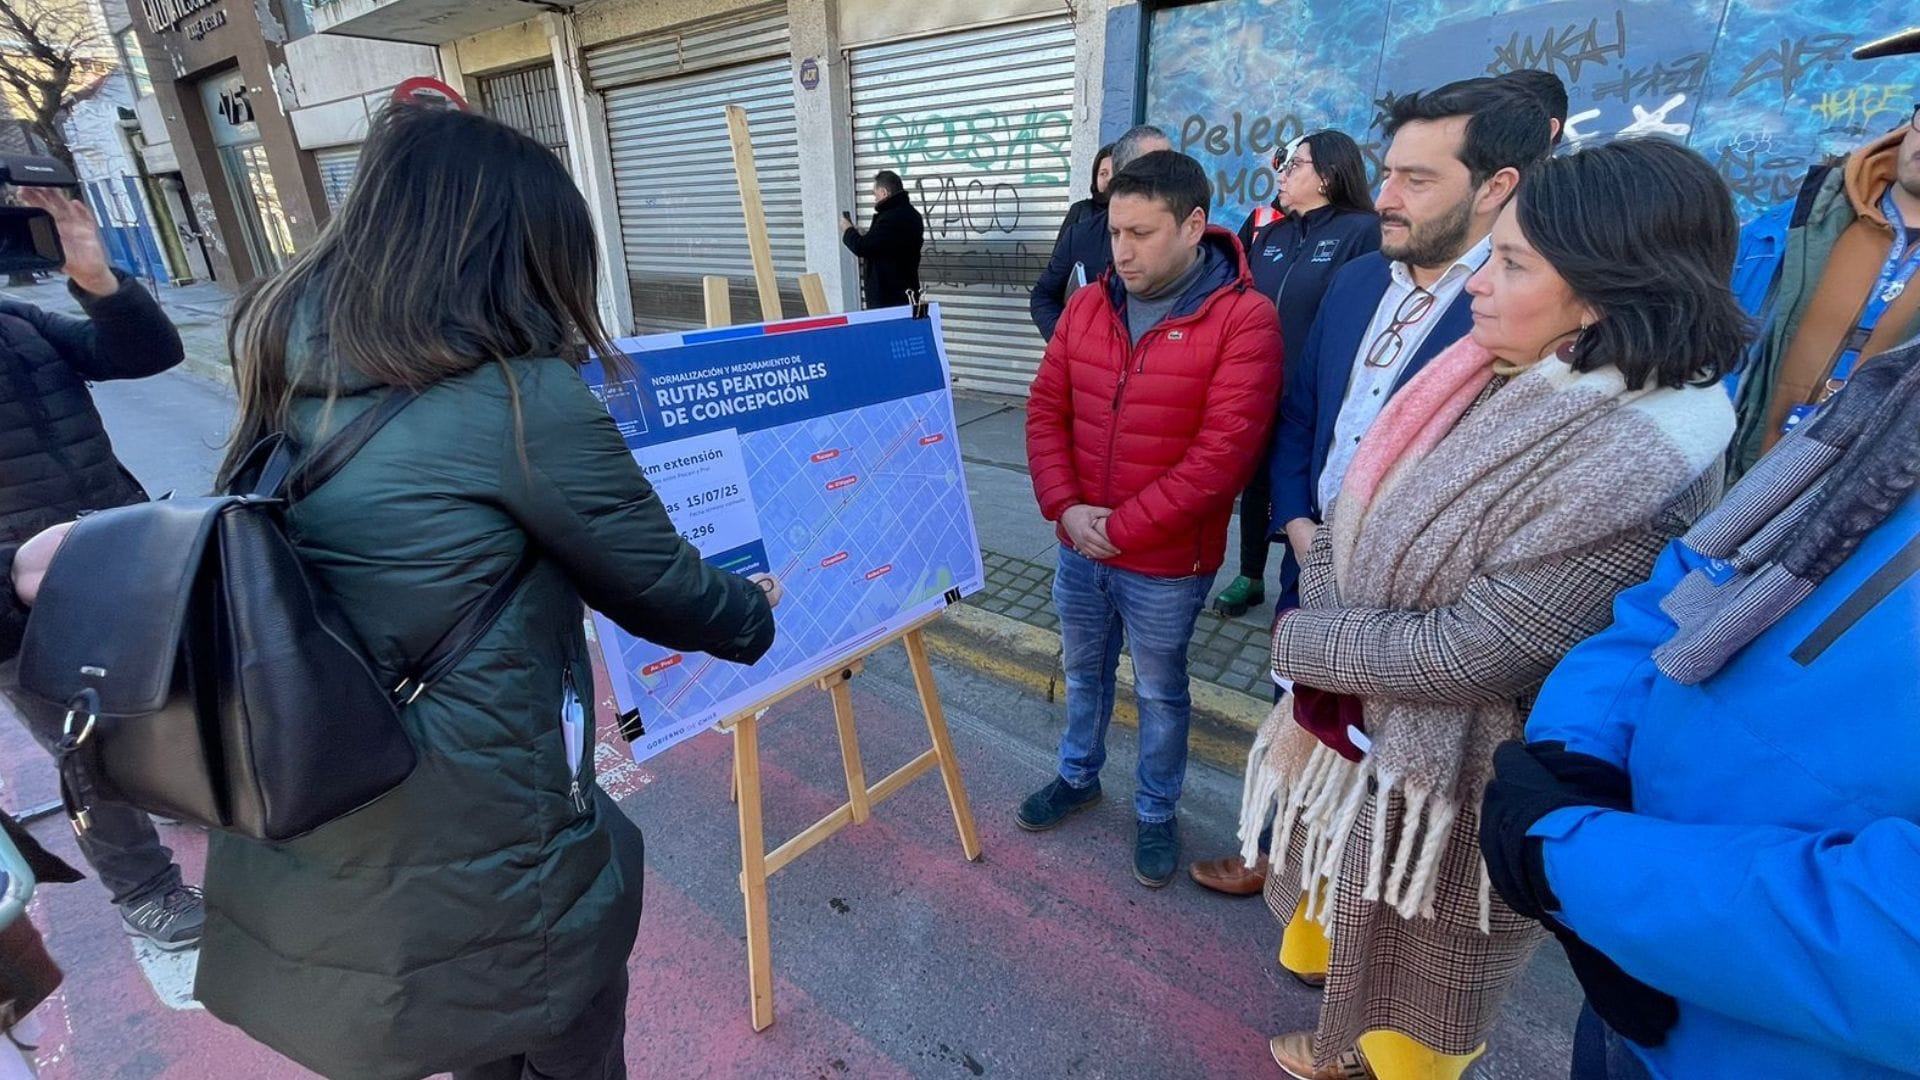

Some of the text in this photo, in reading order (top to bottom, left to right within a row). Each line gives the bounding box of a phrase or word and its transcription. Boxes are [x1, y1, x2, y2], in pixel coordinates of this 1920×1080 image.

[915, 175, 1020, 250] PACO
[651, 355, 801, 386] NORMALIZACIÓN Y MEJORAMIENTO DE
[655, 381, 719, 407] RUTAS
[721, 362, 828, 395] PEATONALES
[661, 409, 689, 428] DE
[691, 384, 810, 422] CONCEPCIÓN
[663, 448, 724, 471] extensión
[665, 484, 739, 514] as 15/07/25
[646, 727, 685, 750] GOBIERNO
